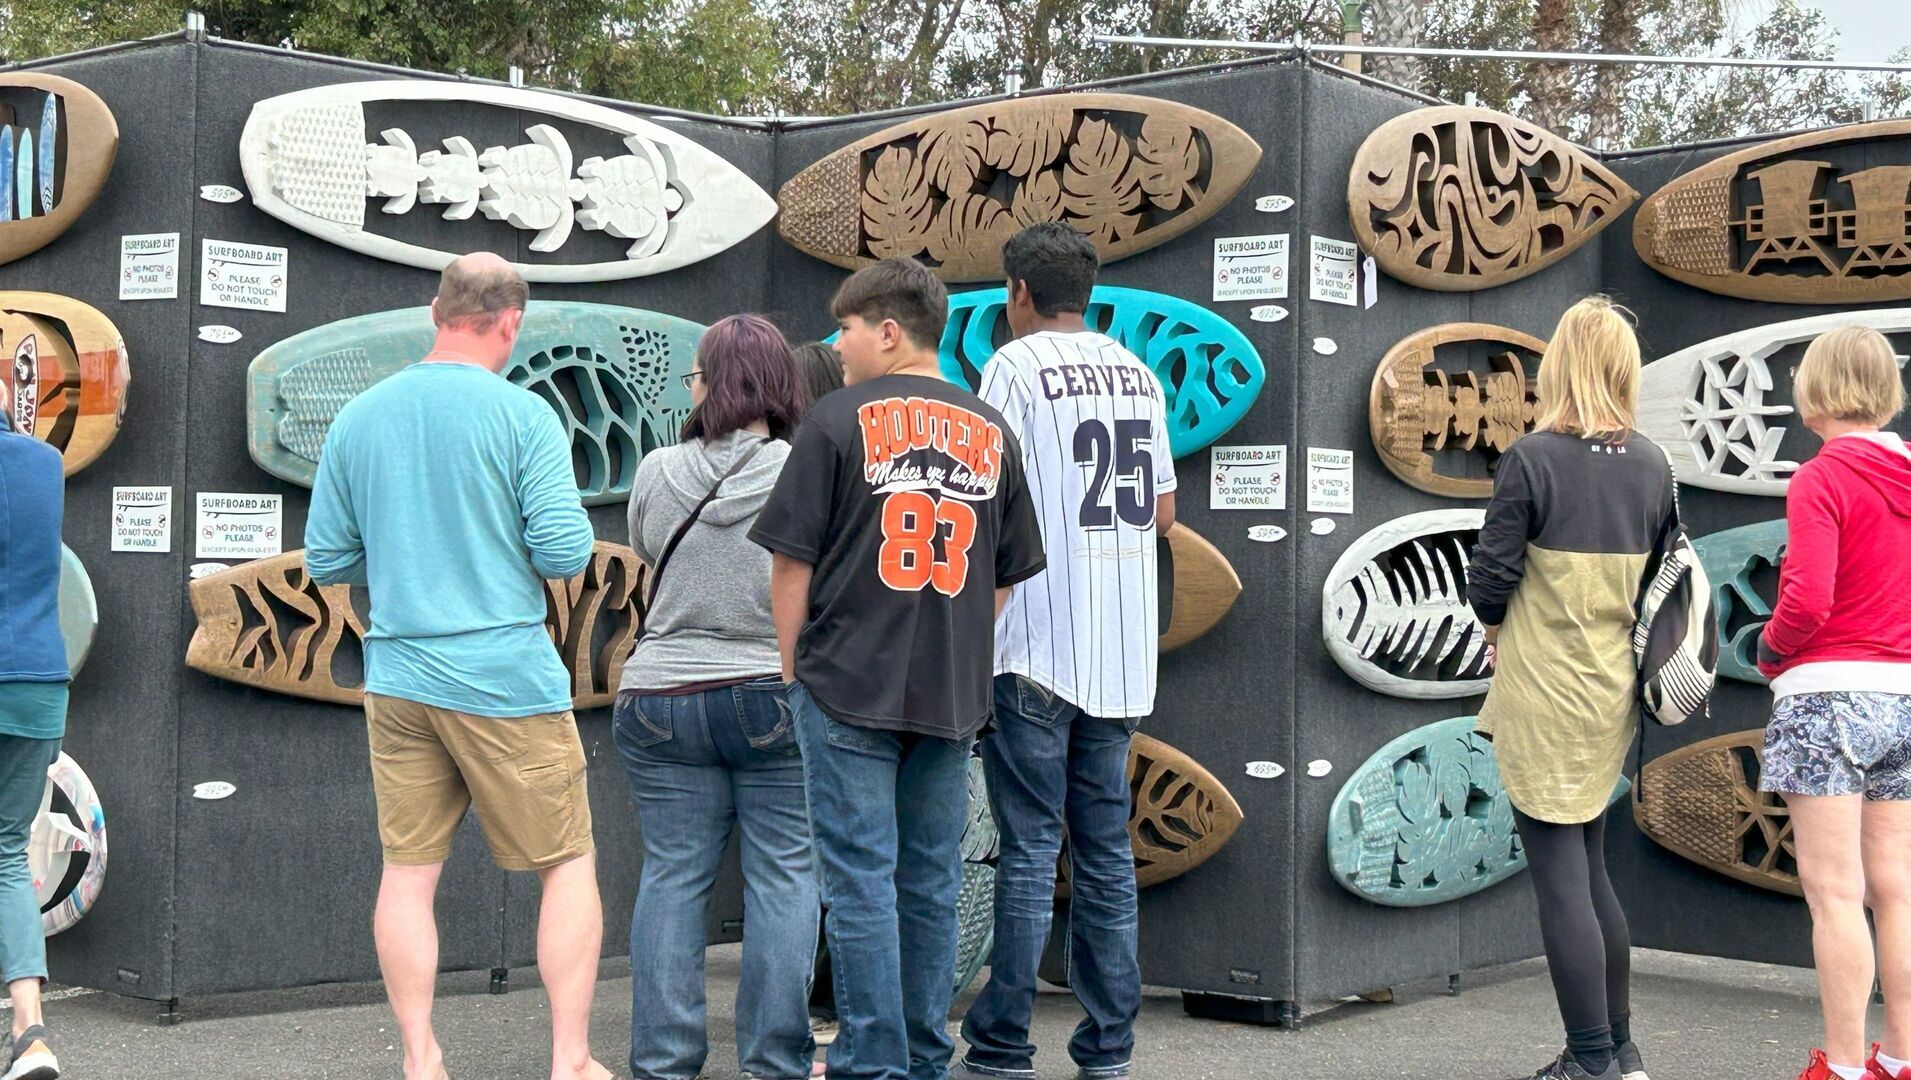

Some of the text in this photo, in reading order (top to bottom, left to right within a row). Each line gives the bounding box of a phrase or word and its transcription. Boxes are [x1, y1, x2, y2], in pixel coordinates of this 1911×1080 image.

[1218, 240, 1284, 253] SURFBOARD ART
[208, 245, 283, 263] SURFBOARD ART
[1230, 265, 1271, 275] NO PHOTOS
[229, 275, 261, 286] PLEASE
[1237, 276, 1263, 285] PLEASE
[211, 283, 278, 297] DO NOT TOUCH
[234, 295, 270, 306] HANDLE
[23, 390, 35, 434] JON
[857, 397, 1004, 483] HOOTERS
[1215, 450, 1281, 461] SURFBOARD ART
[871, 459, 922, 486] Makes
[949, 464, 996, 496] happy
[1073, 419, 1155, 532] 25
[1233, 477, 1262, 485] PLEASE
[155, 491, 167, 501] ART
[1218, 487, 1230, 495] DO
[202, 498, 278, 509] SURFBOARD ART
[1225, 496, 1270, 505] OR HANDLE
[216, 524, 263, 533] NO PHOTOS
[225, 534, 254, 543] PLEASE
[878, 490, 977, 598] 83
